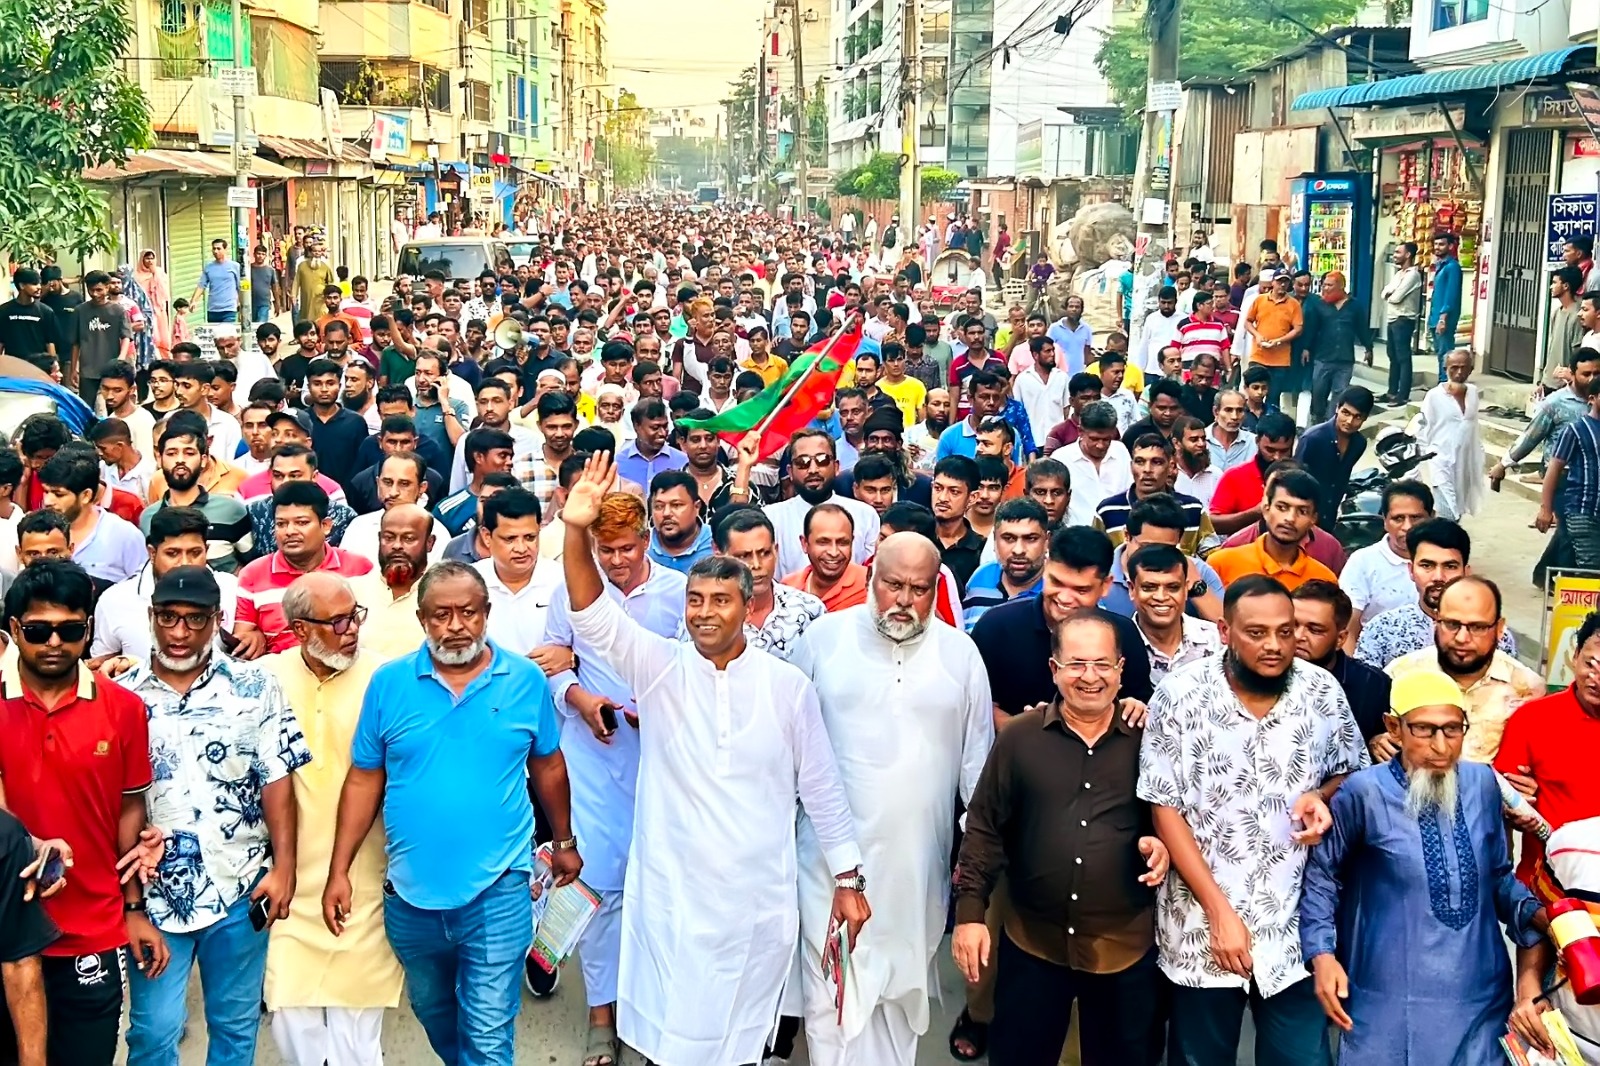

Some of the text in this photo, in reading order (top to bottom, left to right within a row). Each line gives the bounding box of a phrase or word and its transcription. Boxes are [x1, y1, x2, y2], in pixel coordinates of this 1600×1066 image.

[1326, 182, 1349, 191] pepsi
[1551, 197, 1596, 217] সিফাত
[1551, 218, 1595, 236] ফ্যাশন
